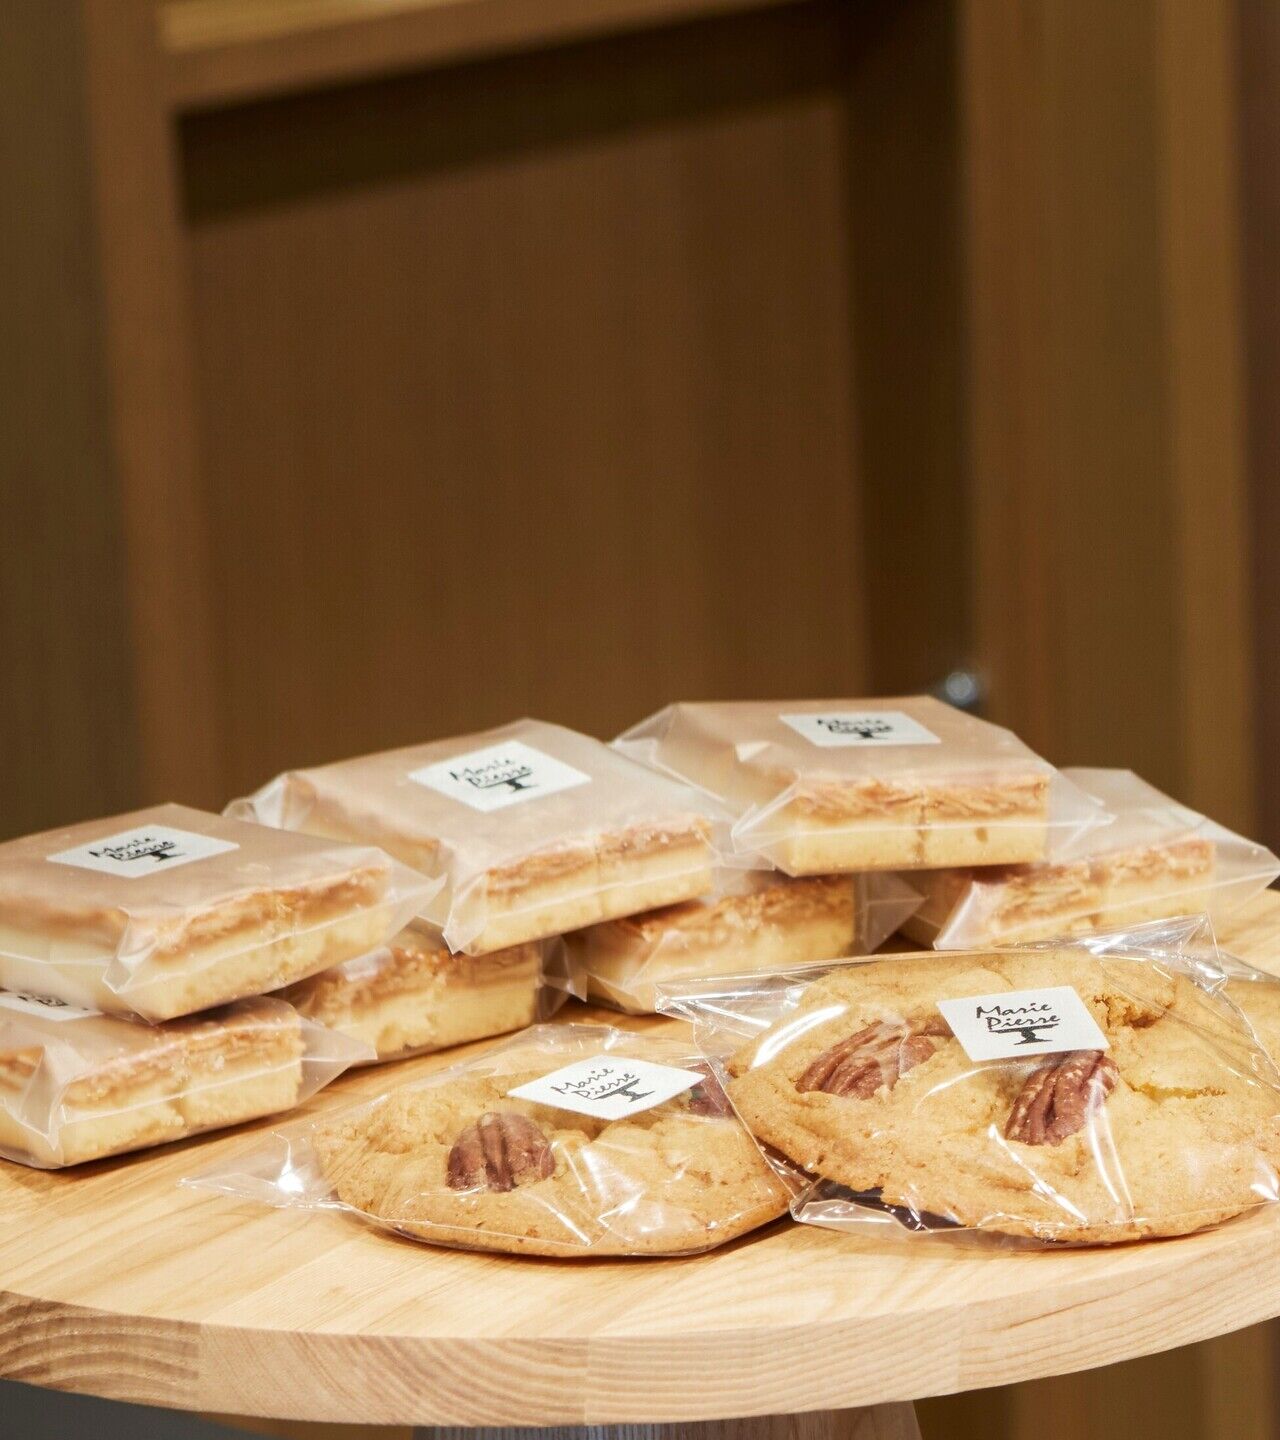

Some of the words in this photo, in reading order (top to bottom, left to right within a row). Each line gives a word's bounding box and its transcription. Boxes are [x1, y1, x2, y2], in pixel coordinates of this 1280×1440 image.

[976, 1002, 1052, 1019] Marie
[985, 1014, 1061, 1030] Pierre
[551, 1068, 614, 1094] Marie
[571, 1073, 635, 1100] Pierre
